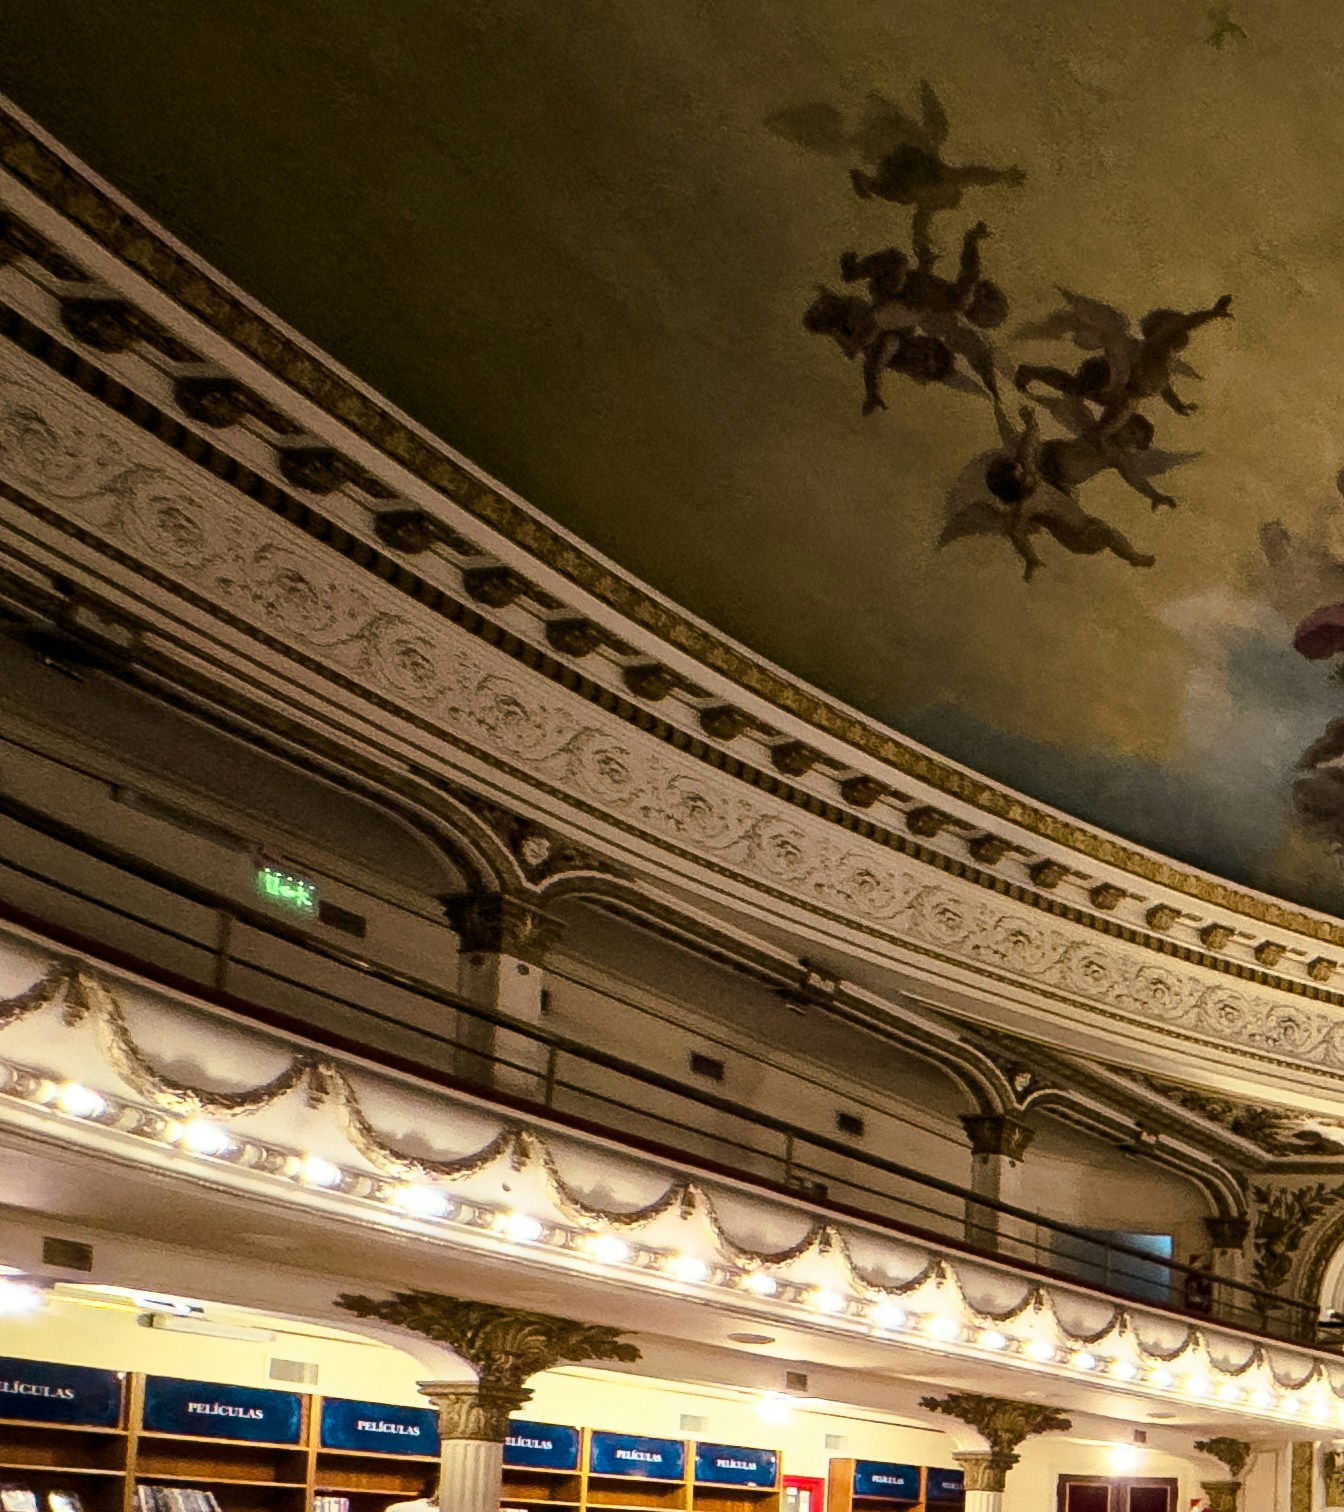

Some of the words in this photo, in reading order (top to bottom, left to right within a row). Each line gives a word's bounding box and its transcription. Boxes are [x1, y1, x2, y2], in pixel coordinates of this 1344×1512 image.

[188, 1401, 264, 1420] PELÍCULAS
[357, 1420, 421, 1437] PELÍCULAS
[505, 1436, 553, 1450] ELÍCULAS
